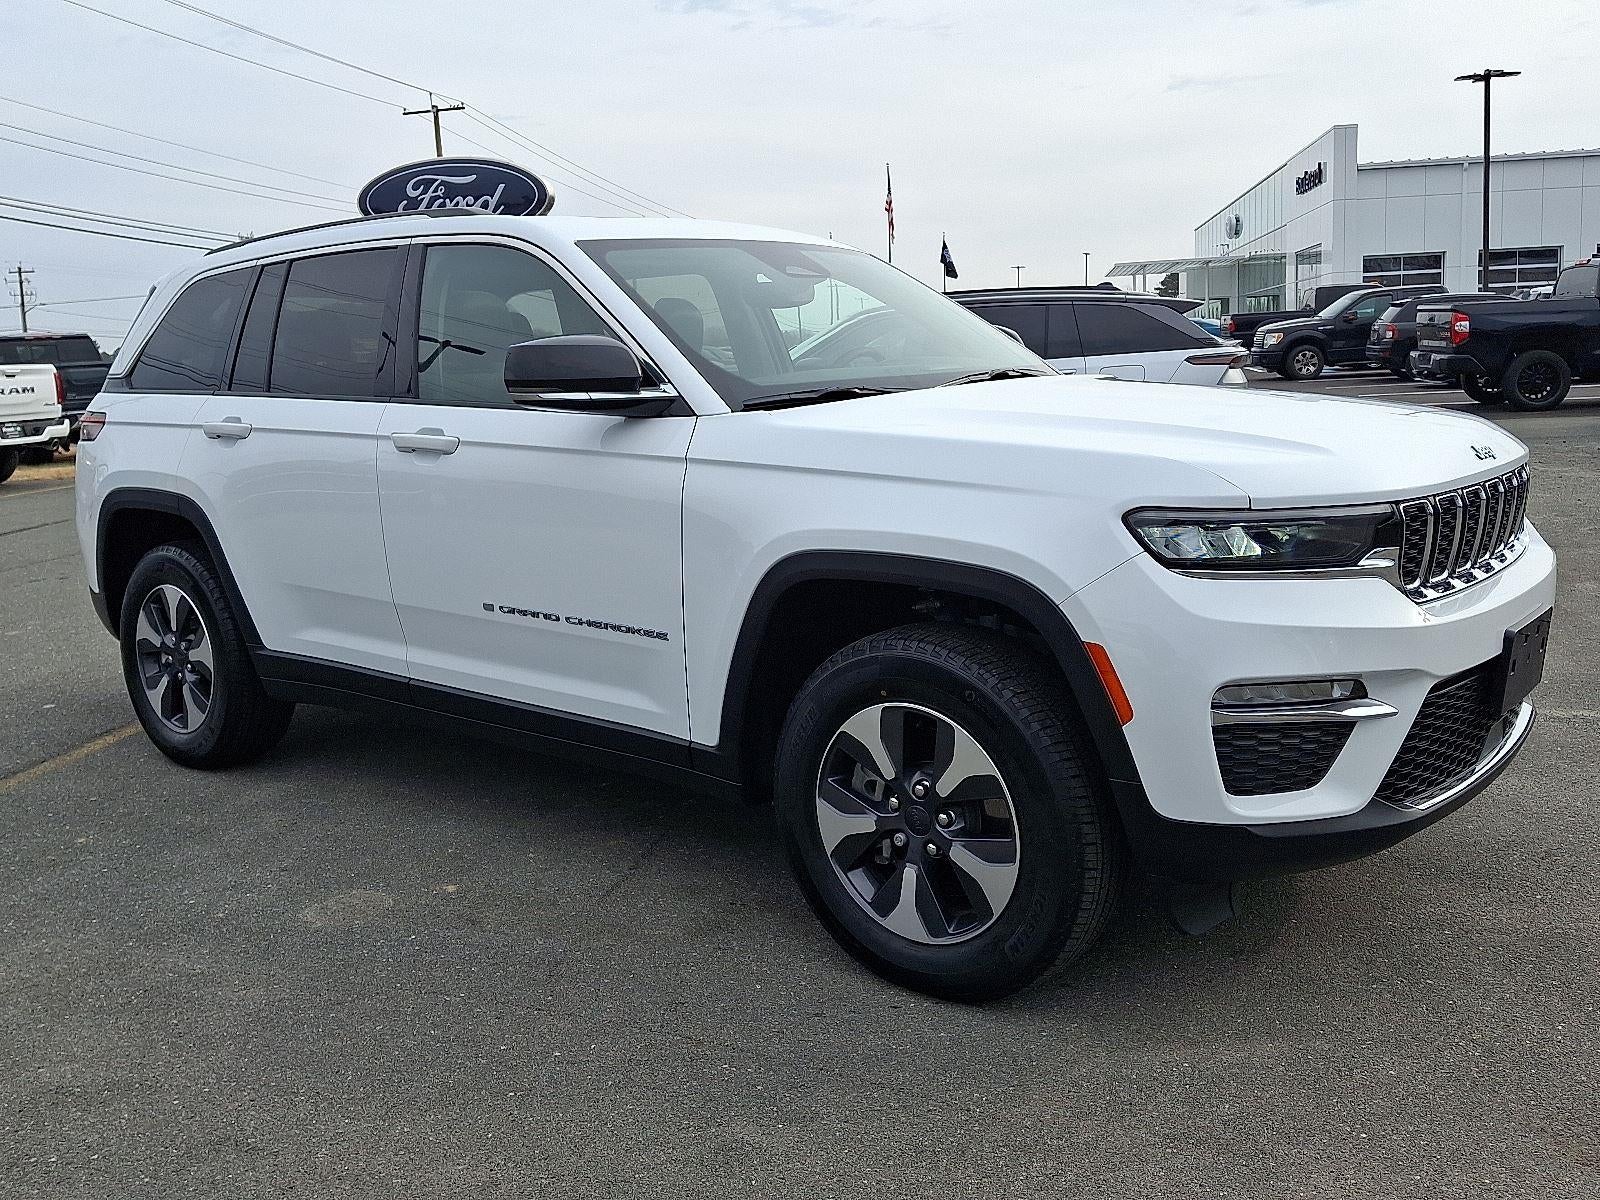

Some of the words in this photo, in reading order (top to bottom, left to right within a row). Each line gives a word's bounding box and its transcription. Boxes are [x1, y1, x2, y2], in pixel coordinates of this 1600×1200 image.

[398, 174, 506, 214] Ford
[1470, 445, 1497, 461] Jeep
[498, 604, 561, 622] GRAND
[564, 615, 670, 642] CHEROKEE
